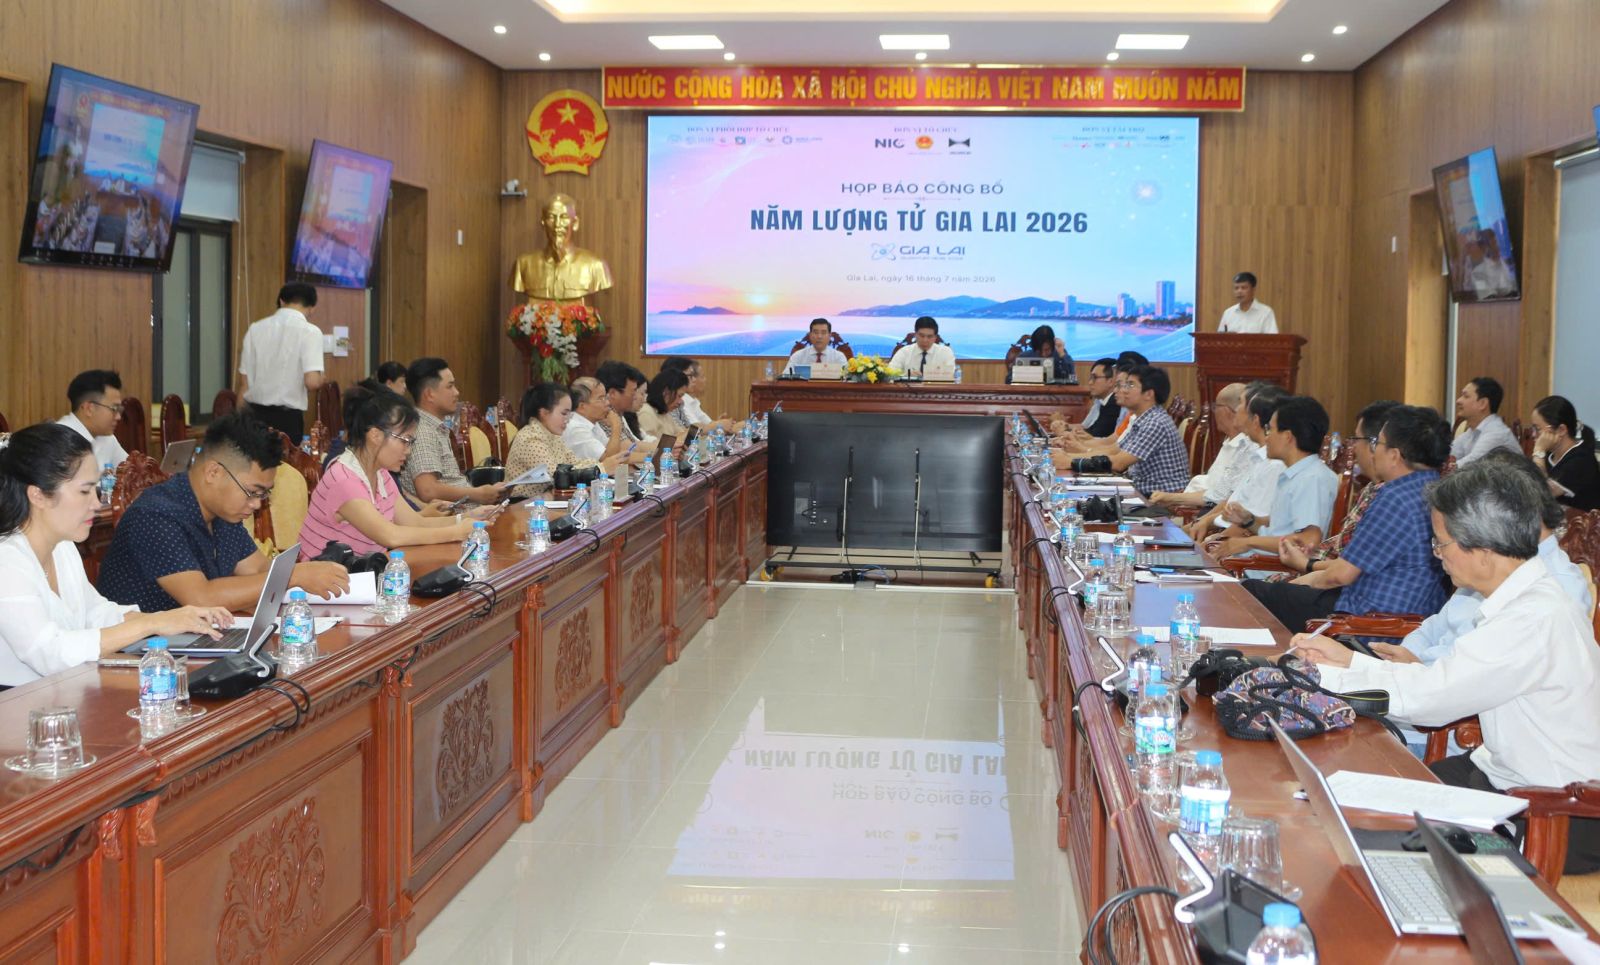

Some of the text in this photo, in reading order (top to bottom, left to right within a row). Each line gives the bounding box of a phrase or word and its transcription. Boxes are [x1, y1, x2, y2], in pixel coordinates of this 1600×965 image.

[607, 69, 666, 99] NƯỚC
[674, 69, 733, 106] CỘNG
[740, 70, 784, 99] HÒA
[791, 70, 823, 99] XÃ
[831, 70, 866, 107] HỘI
[873, 67, 918, 99] CHỦ
[924, 70, 992, 100] NGHĨA
[998, 70, 1044, 107] VIỆT
[1052, 75, 1104, 100] NAM
[1187, 71, 1240, 101] NĂM
[875, 138, 905, 149] NIC
[841, 179, 1004, 196] HỌP BÁO CÔNG BỐ
[751, 203, 1088, 236] NĂM LƯỢNG TỬ GIA LAI 2026
[900, 246, 965, 255] GIA LAI
